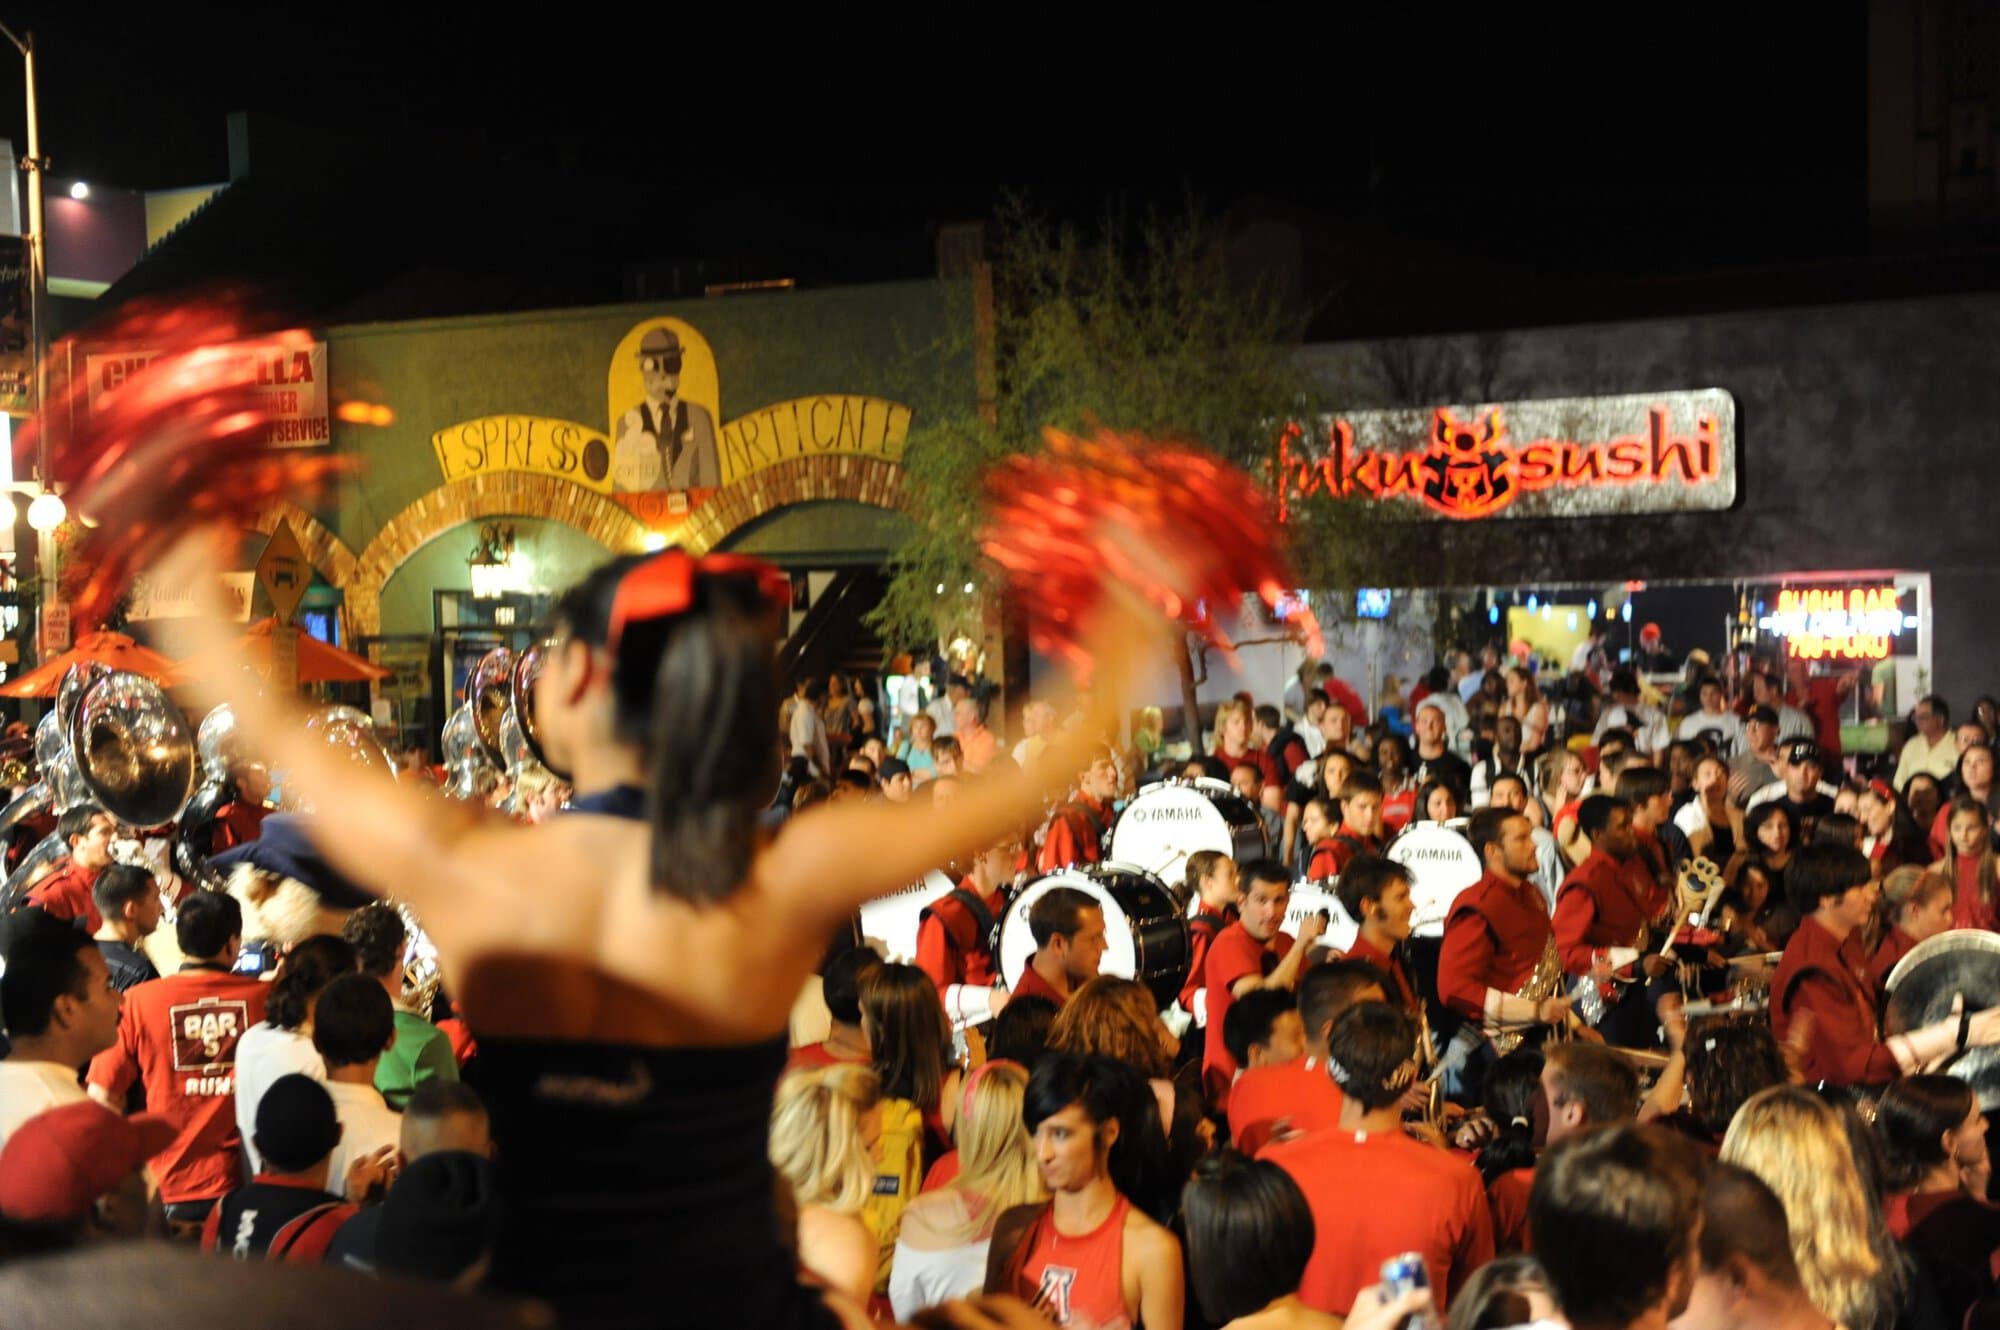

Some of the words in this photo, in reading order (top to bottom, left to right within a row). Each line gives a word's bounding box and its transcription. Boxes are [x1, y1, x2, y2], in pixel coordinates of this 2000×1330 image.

[276, 416, 328, 442] SERVICE
[438, 417, 609, 482] ESPRESSO
[1264, 417, 1422, 524] fuku
[1518, 405, 1720, 491] sushi
[1151, 807, 1202, 821] YAMAHA
[1415, 848, 1463, 862] YAMAHA
[184, 1011, 238, 1041] BAR
